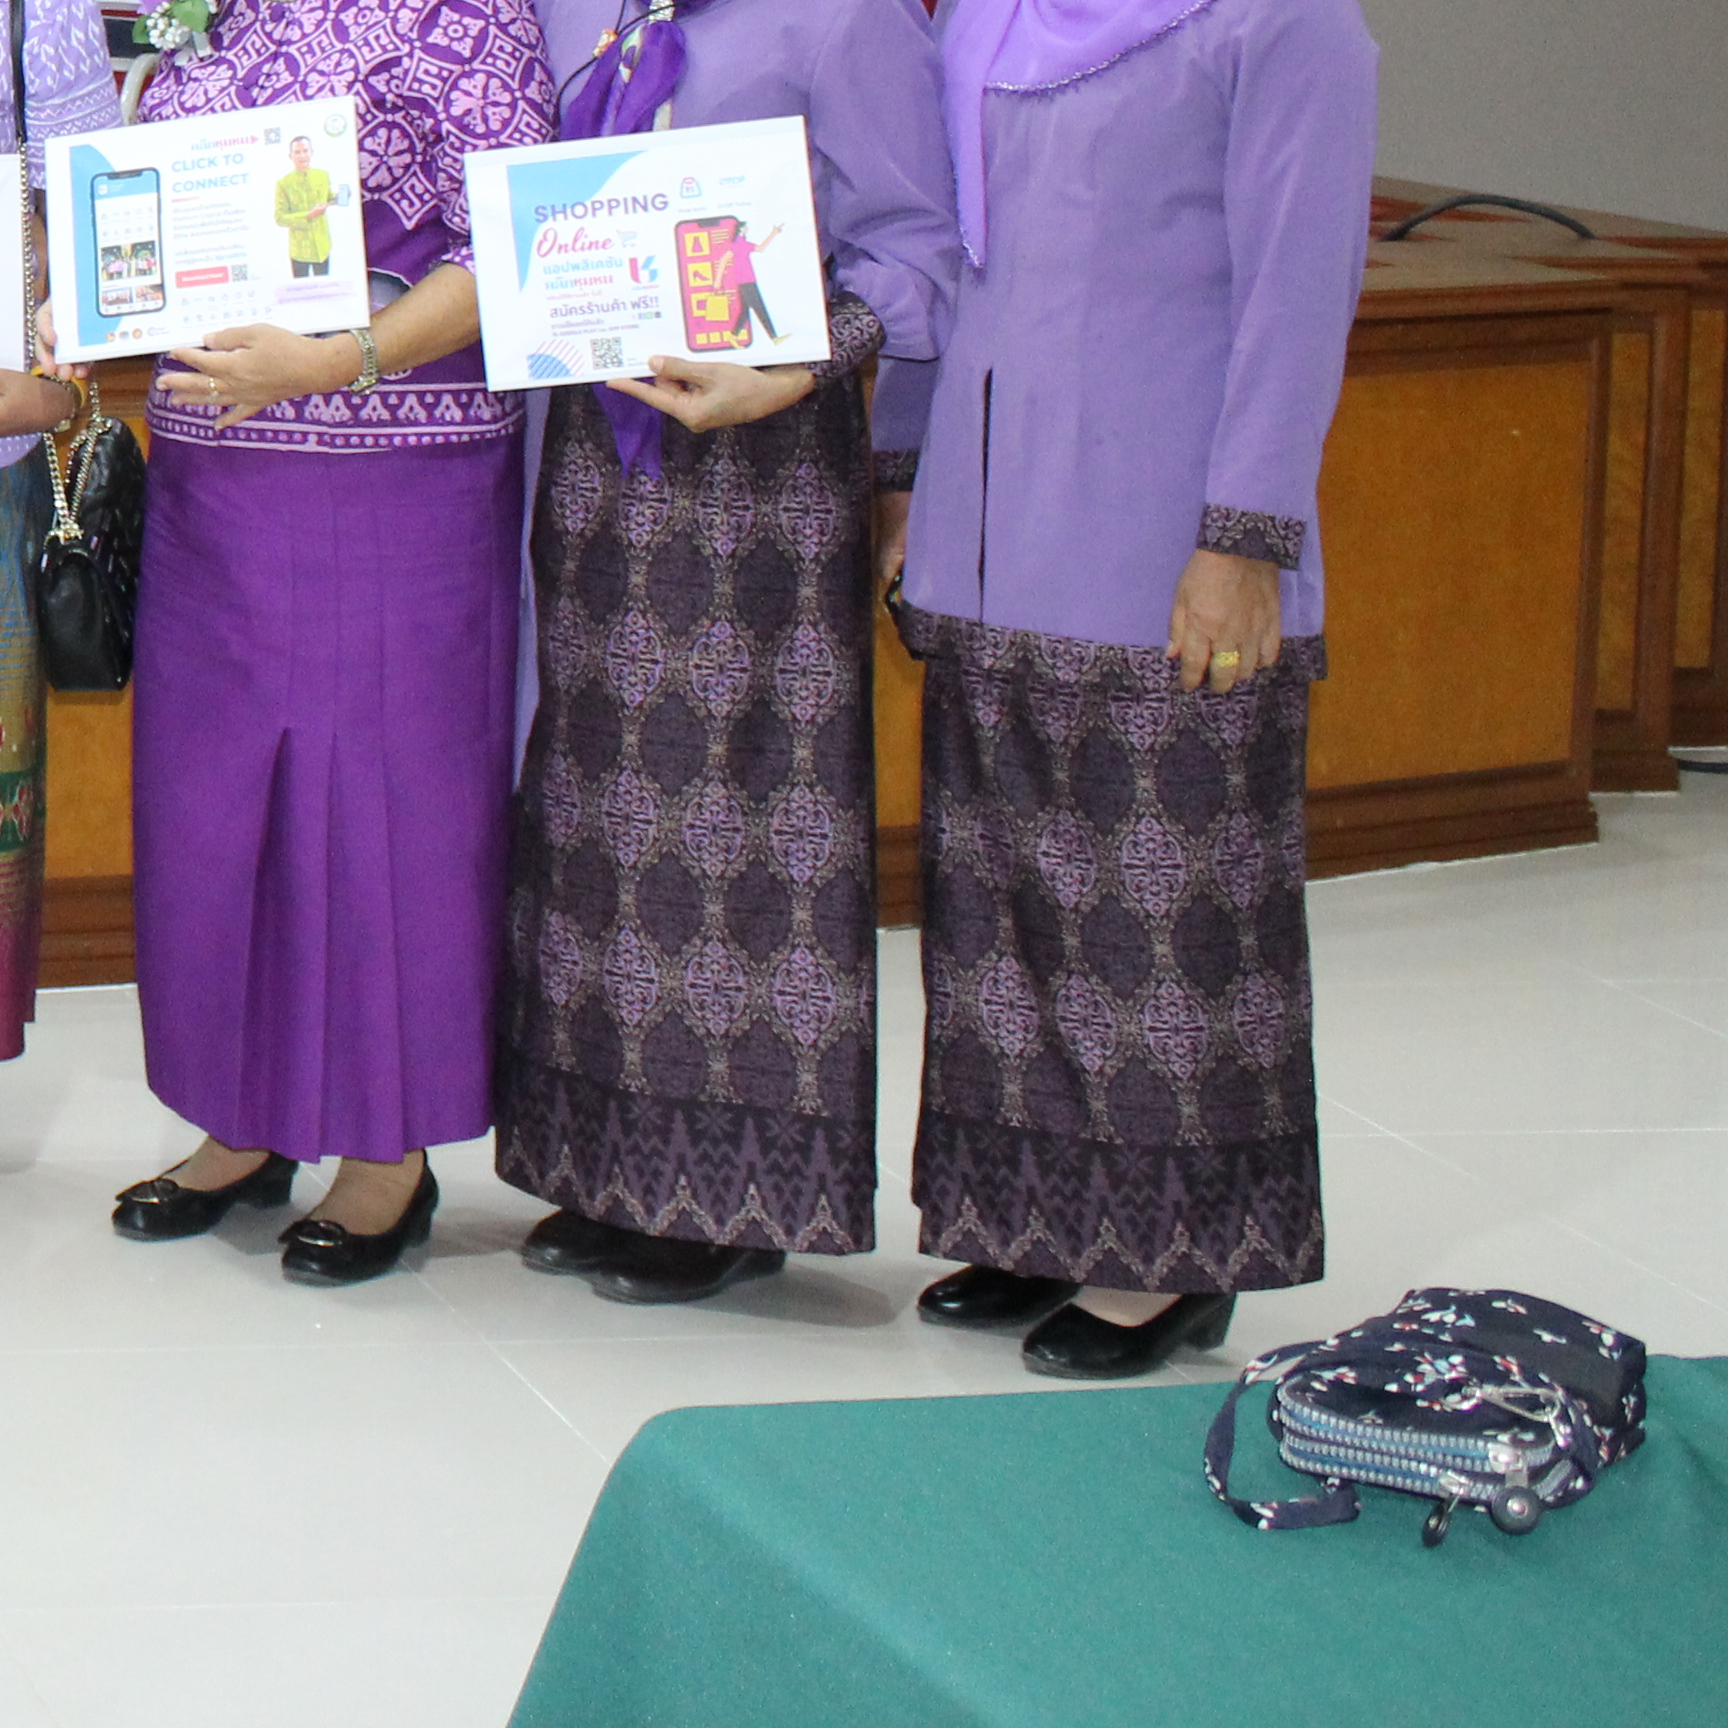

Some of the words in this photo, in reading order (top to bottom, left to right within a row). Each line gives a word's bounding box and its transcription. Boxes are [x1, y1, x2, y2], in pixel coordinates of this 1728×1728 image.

[171, 156, 218, 173] CLICK
[222, 153, 245, 166] TO
[171, 173, 249, 194] CONNECT
[533, 192, 670, 224] SHOPPING
[536, 226, 615, 259] Online
[549, 297, 627, 319] สมัครร้านค้า
